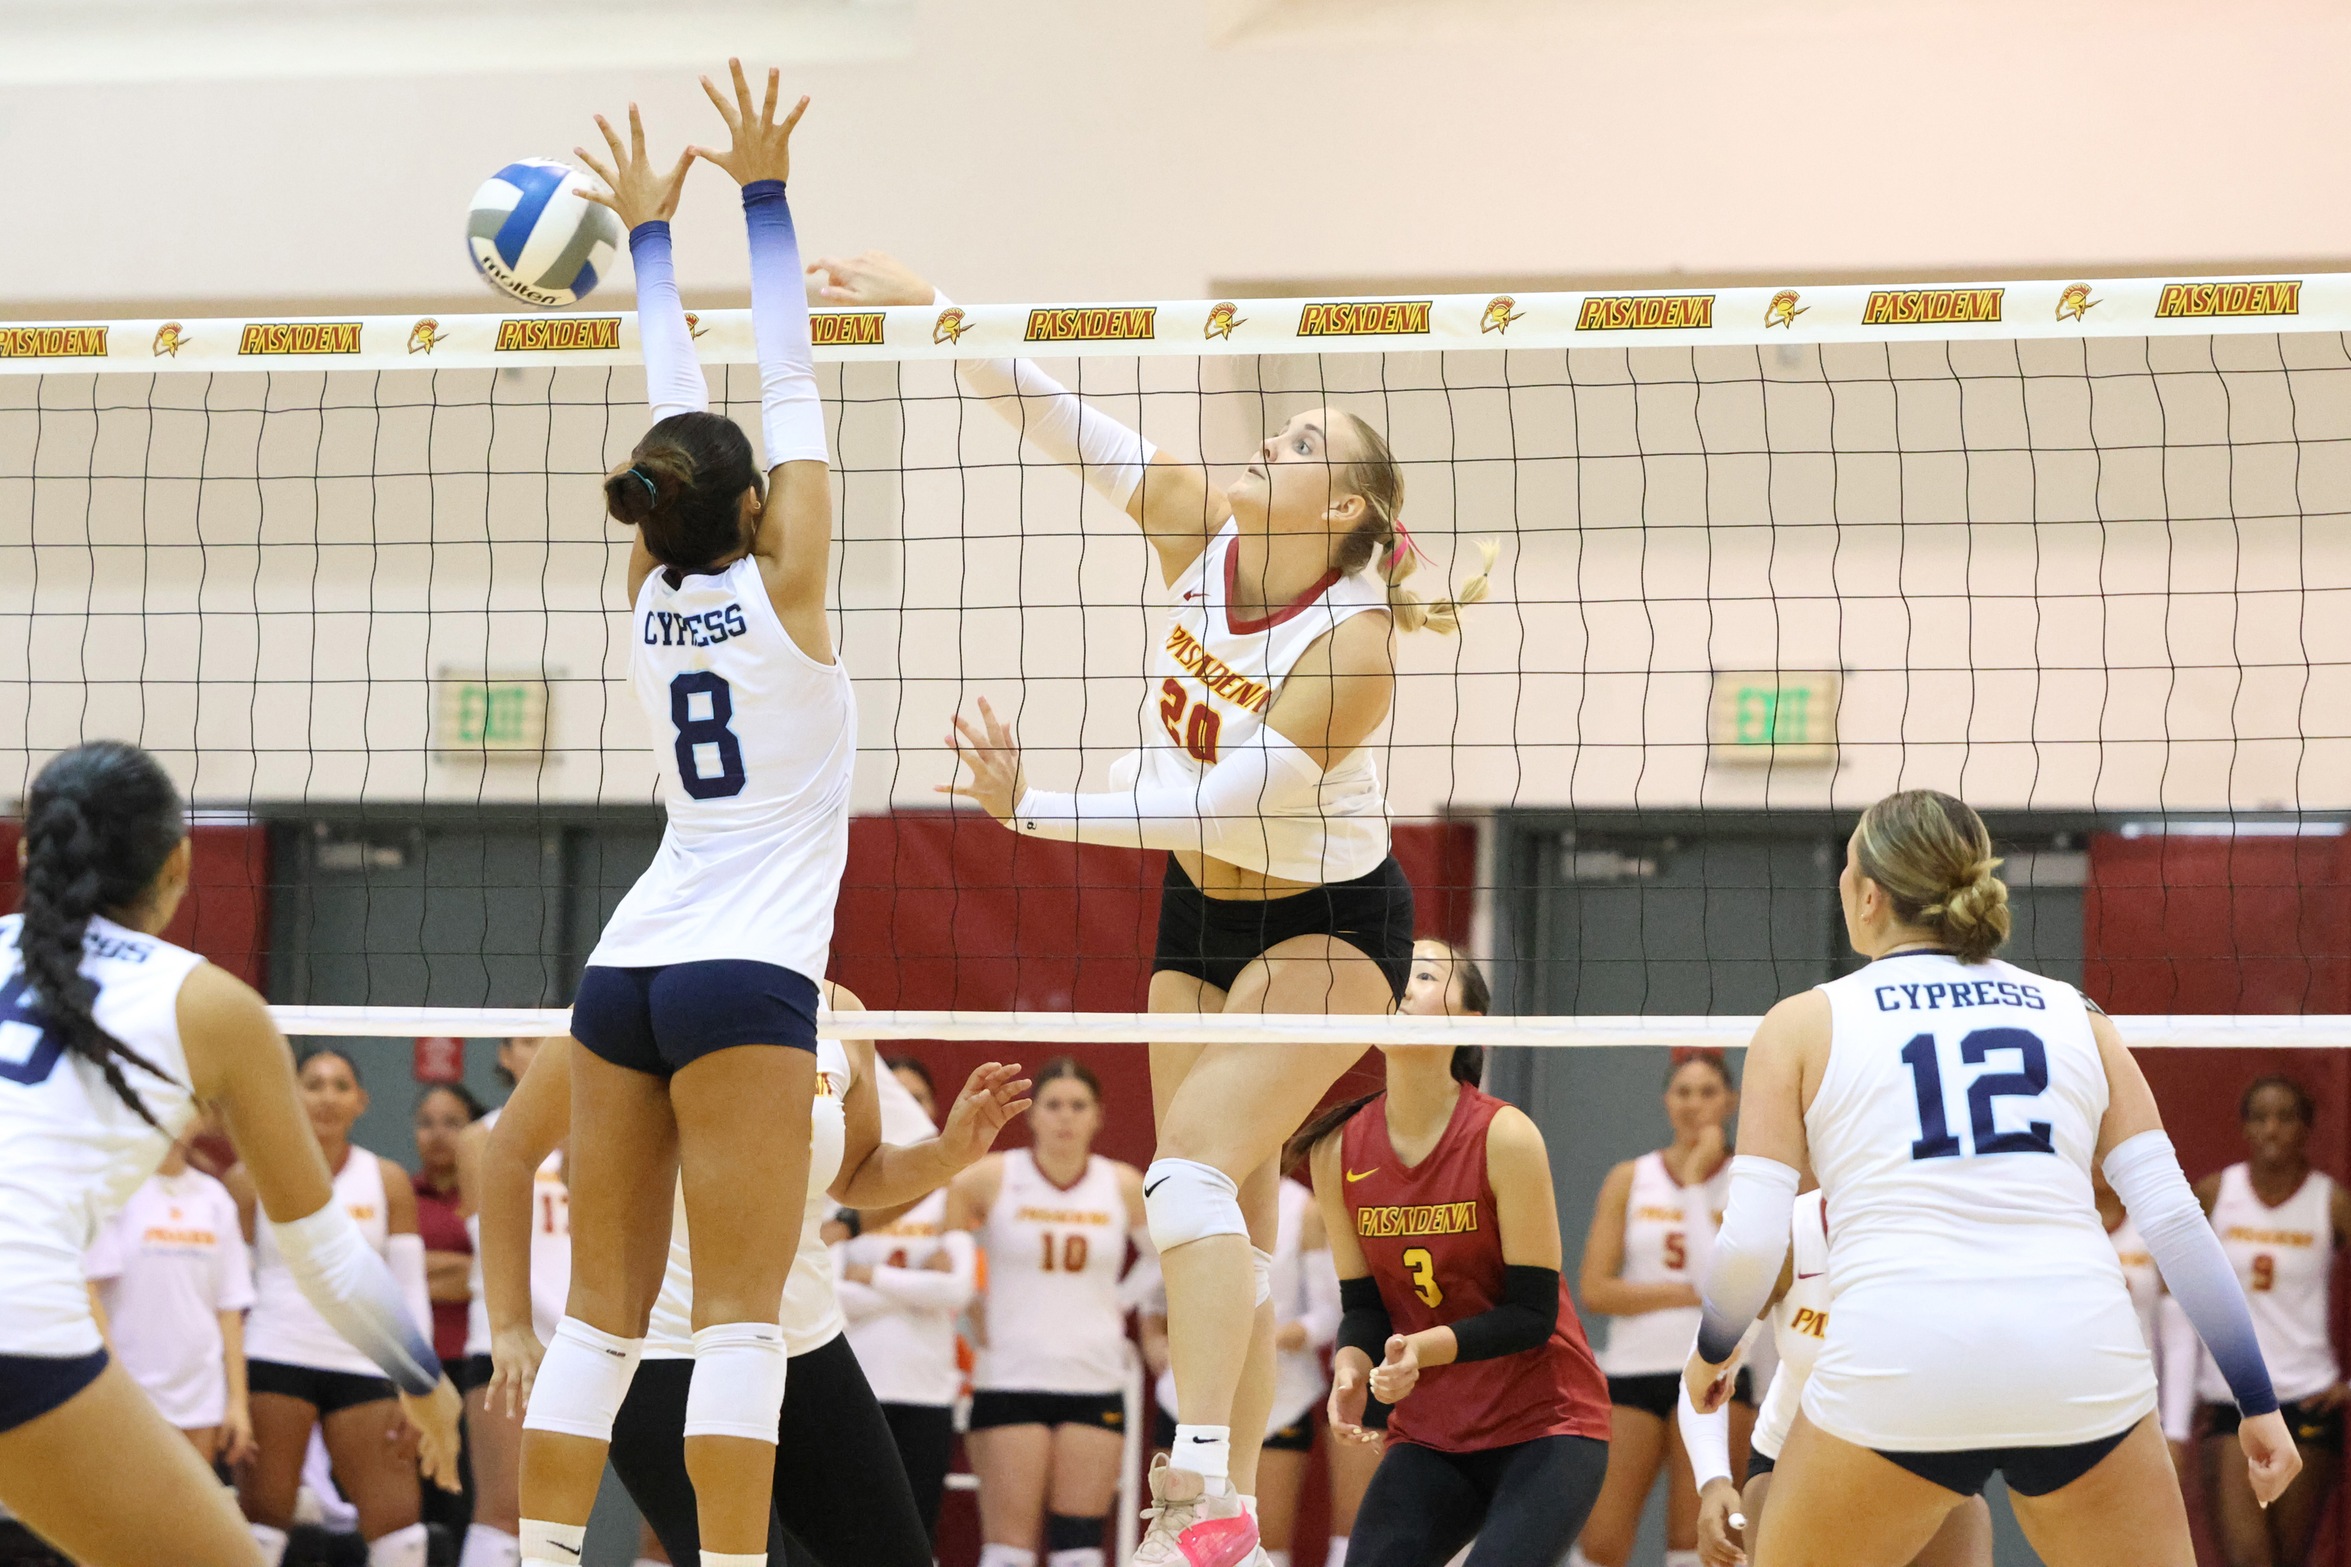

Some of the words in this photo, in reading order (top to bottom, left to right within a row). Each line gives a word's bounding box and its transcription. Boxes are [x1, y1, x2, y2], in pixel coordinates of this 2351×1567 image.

[483, 256, 558, 304] molten
[2155, 280, 2303, 318] PASADENA
[1024, 306, 1157, 341] PASADENA
[1296, 300, 1433, 337] PASADENA
[1575, 294, 1716, 331] PASADENA
[1862, 288, 2005, 325] PASADENA
[238, 322, 363, 355] PASADENA
[495, 317, 621, 351] PASADENA
[809, 312, 886, 346] ADENA
[644, 603, 747, 648] CYPESS
[1165, 622, 1273, 714] PASADENA
[670, 670, 748, 801] 8
[1160, 676, 1222, 766] 20
[1874, 980, 2047, 1012] CYPRESS
[1900, 1026, 2056, 1161] 12
[1357, 1200, 1478, 1238] PASADENA
[1040, 1231, 1090, 1274] 10
[1402, 1247, 1444, 1309] 3
